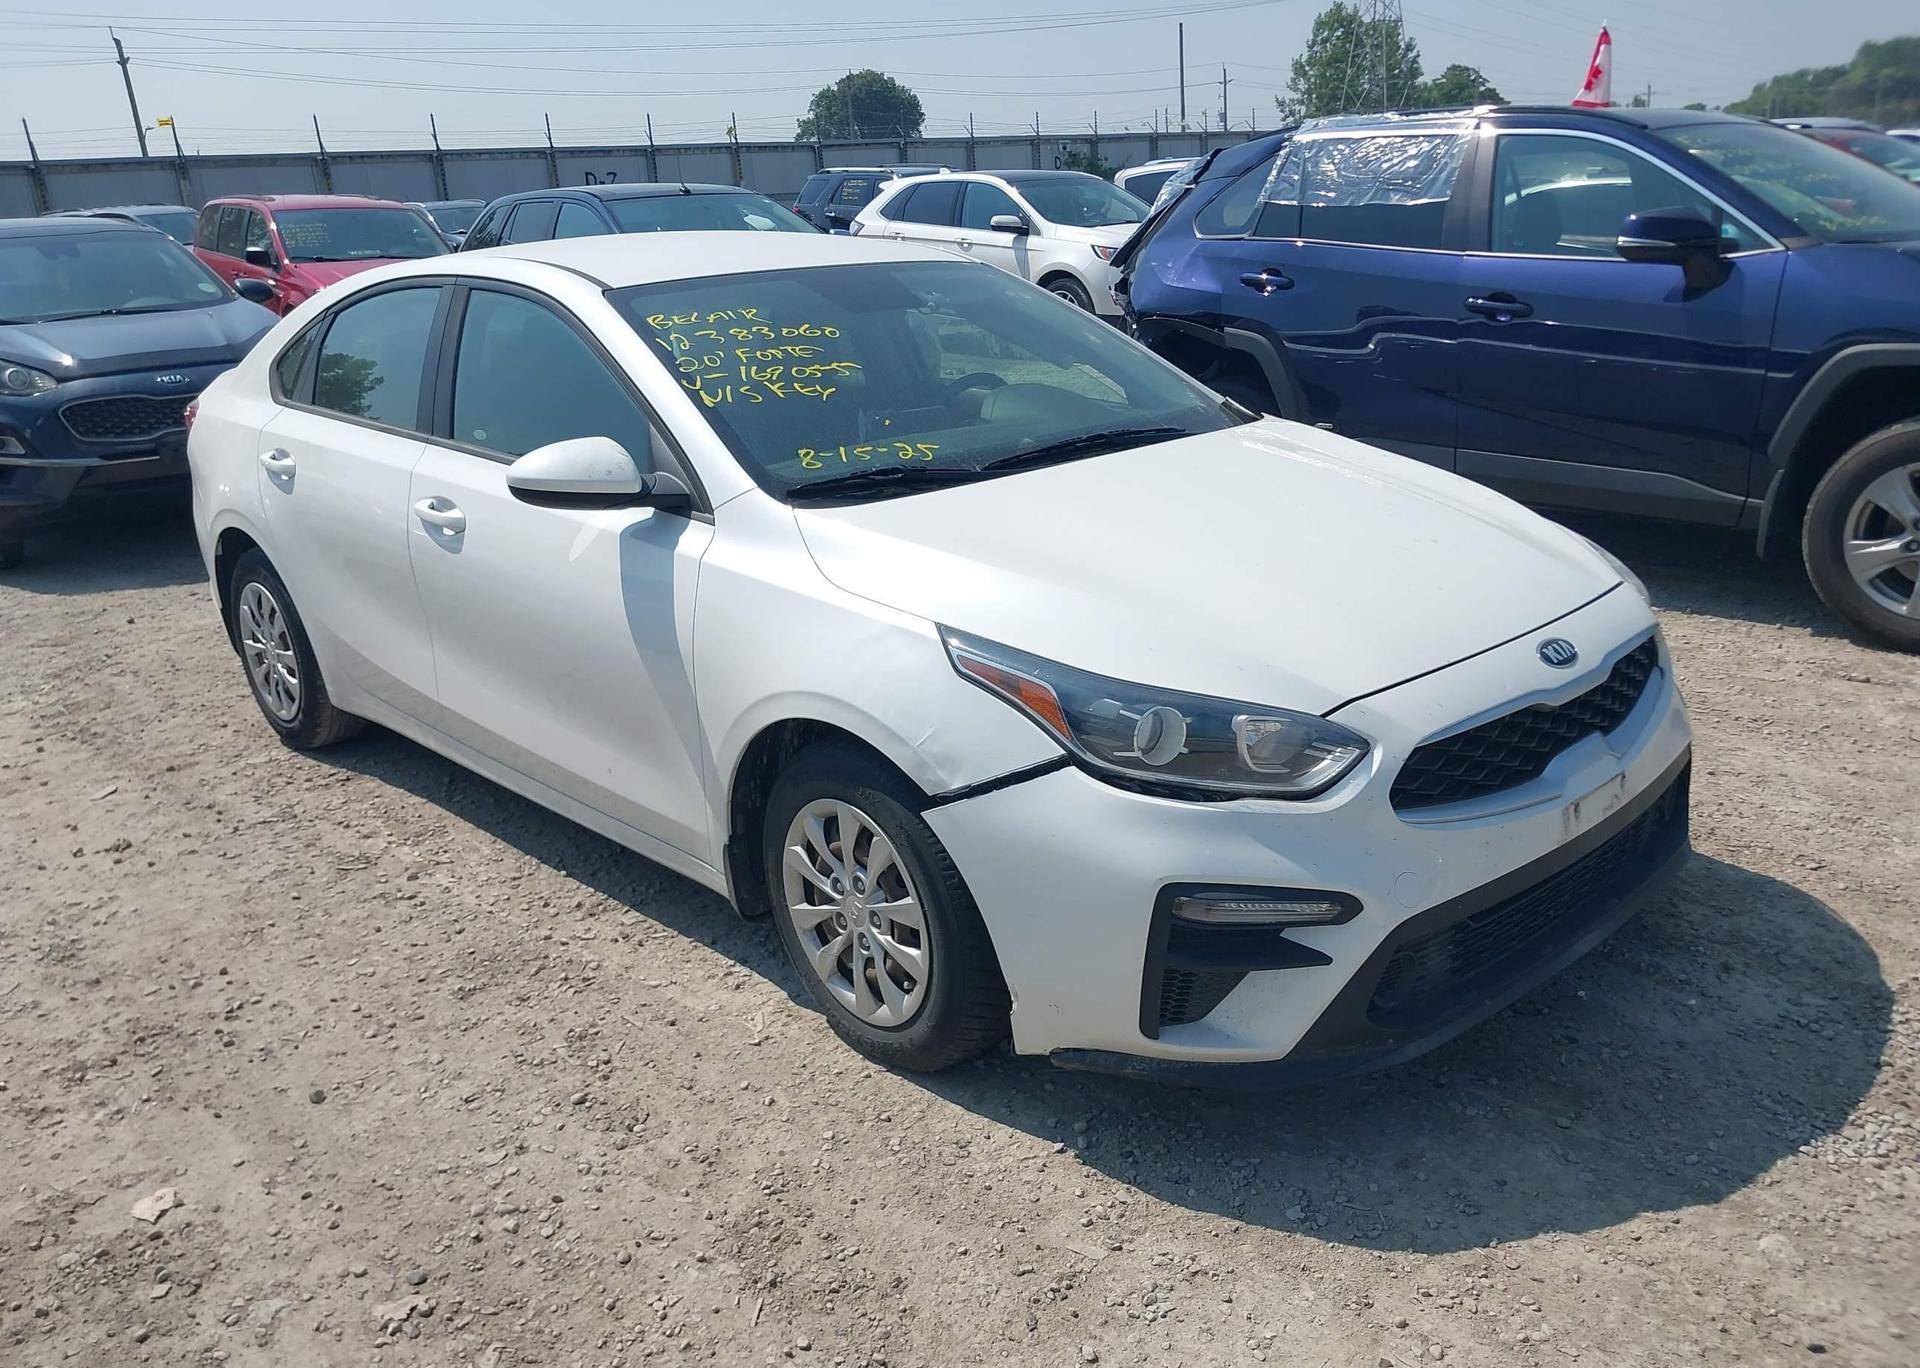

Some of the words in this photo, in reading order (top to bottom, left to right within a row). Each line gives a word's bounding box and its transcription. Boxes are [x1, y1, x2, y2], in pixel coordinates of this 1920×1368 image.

[733, 345, 825, 363] FORTE
[161, 374, 185, 384] KIA
[797, 442, 941, 470] 8-15-25
[1541, 640, 1576, 664] KIA
